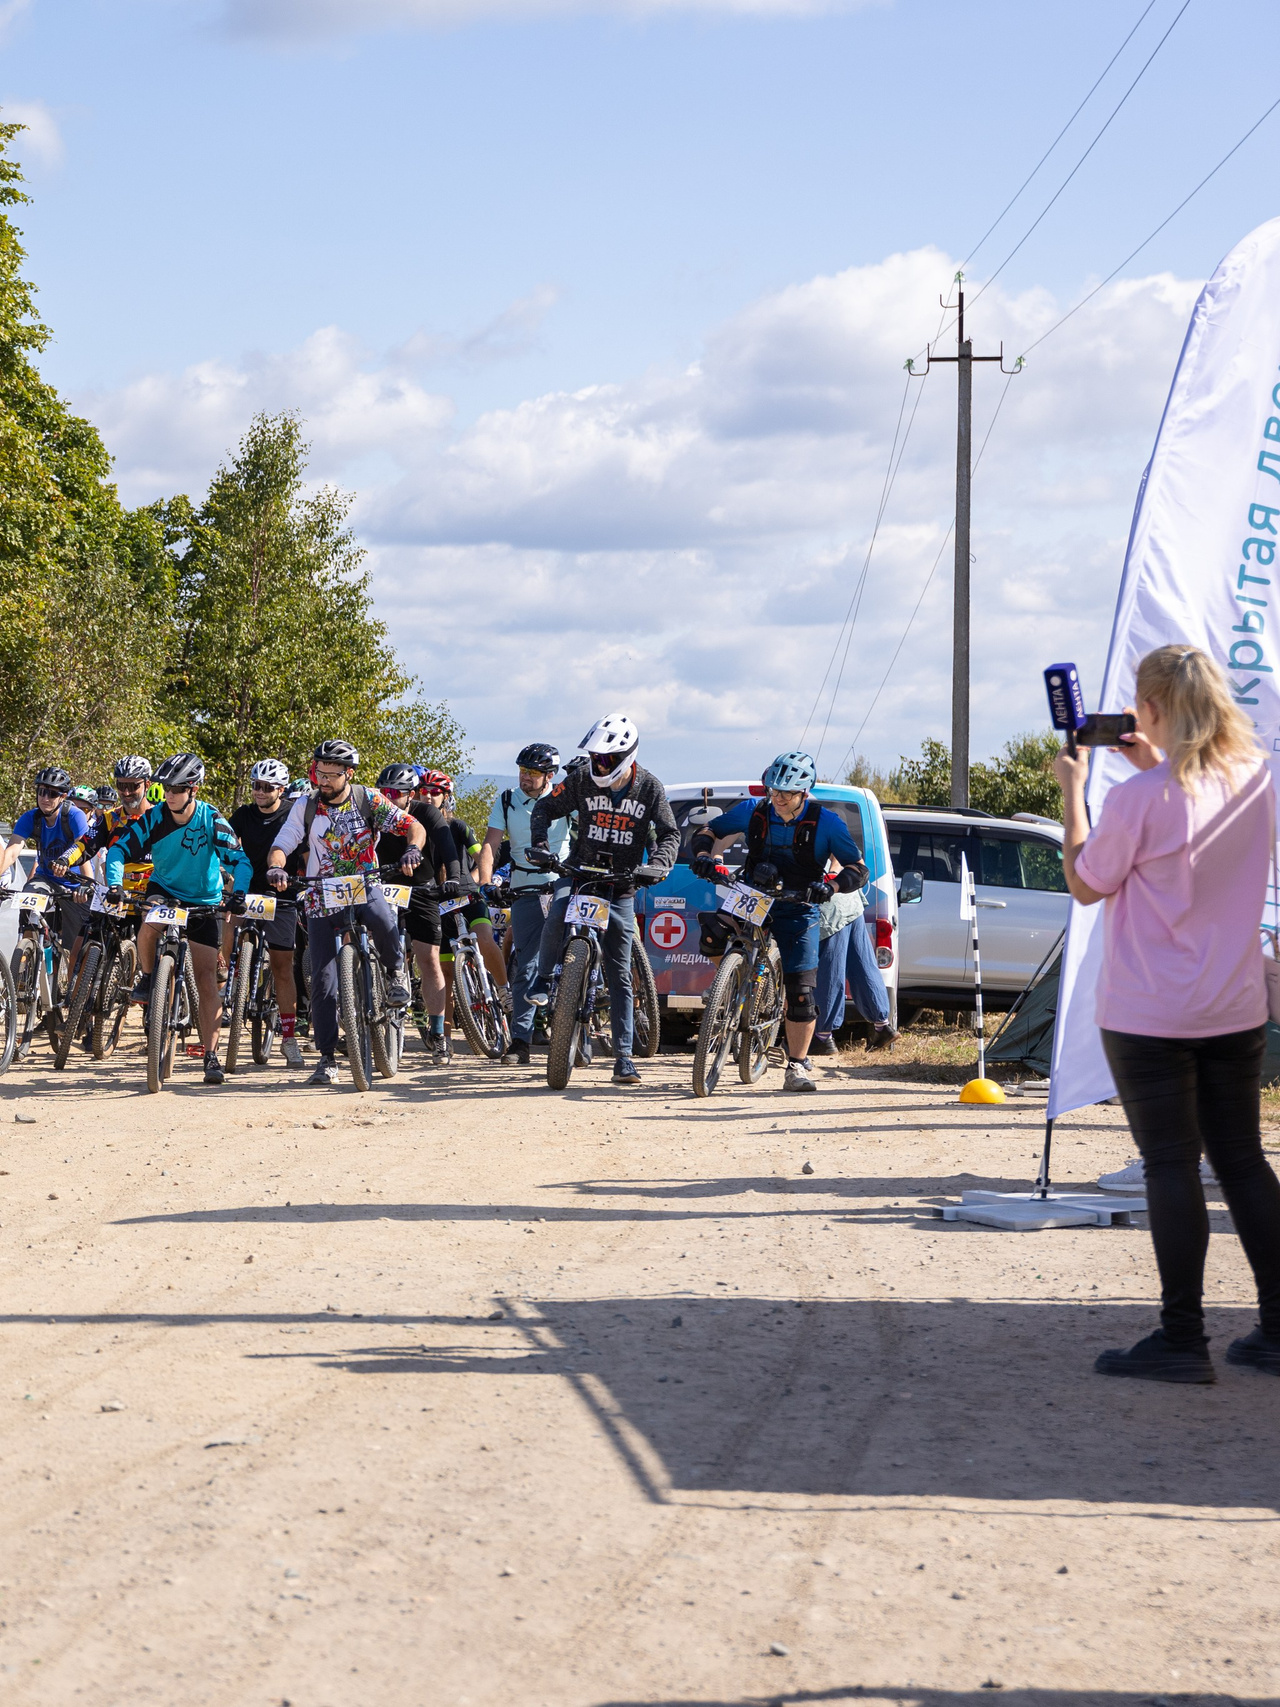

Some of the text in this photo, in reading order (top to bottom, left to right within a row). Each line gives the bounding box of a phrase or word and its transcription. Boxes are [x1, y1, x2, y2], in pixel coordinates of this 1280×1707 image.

[1051, 688, 1069, 724] ЛЕНТА
[1072, 682, 1085, 718] ЛЕНТА
[335, 882, 353, 900] 51
[383, 887, 400, 898] 87
[22, 896, 38, 906] 45
[248, 900, 265, 914] 46
[158, 908, 176, 919] 58
[579, 902, 600, 919] 57
[494, 913, 507, 925] 92
[664, 953, 713, 966] #МЕДИЦ
